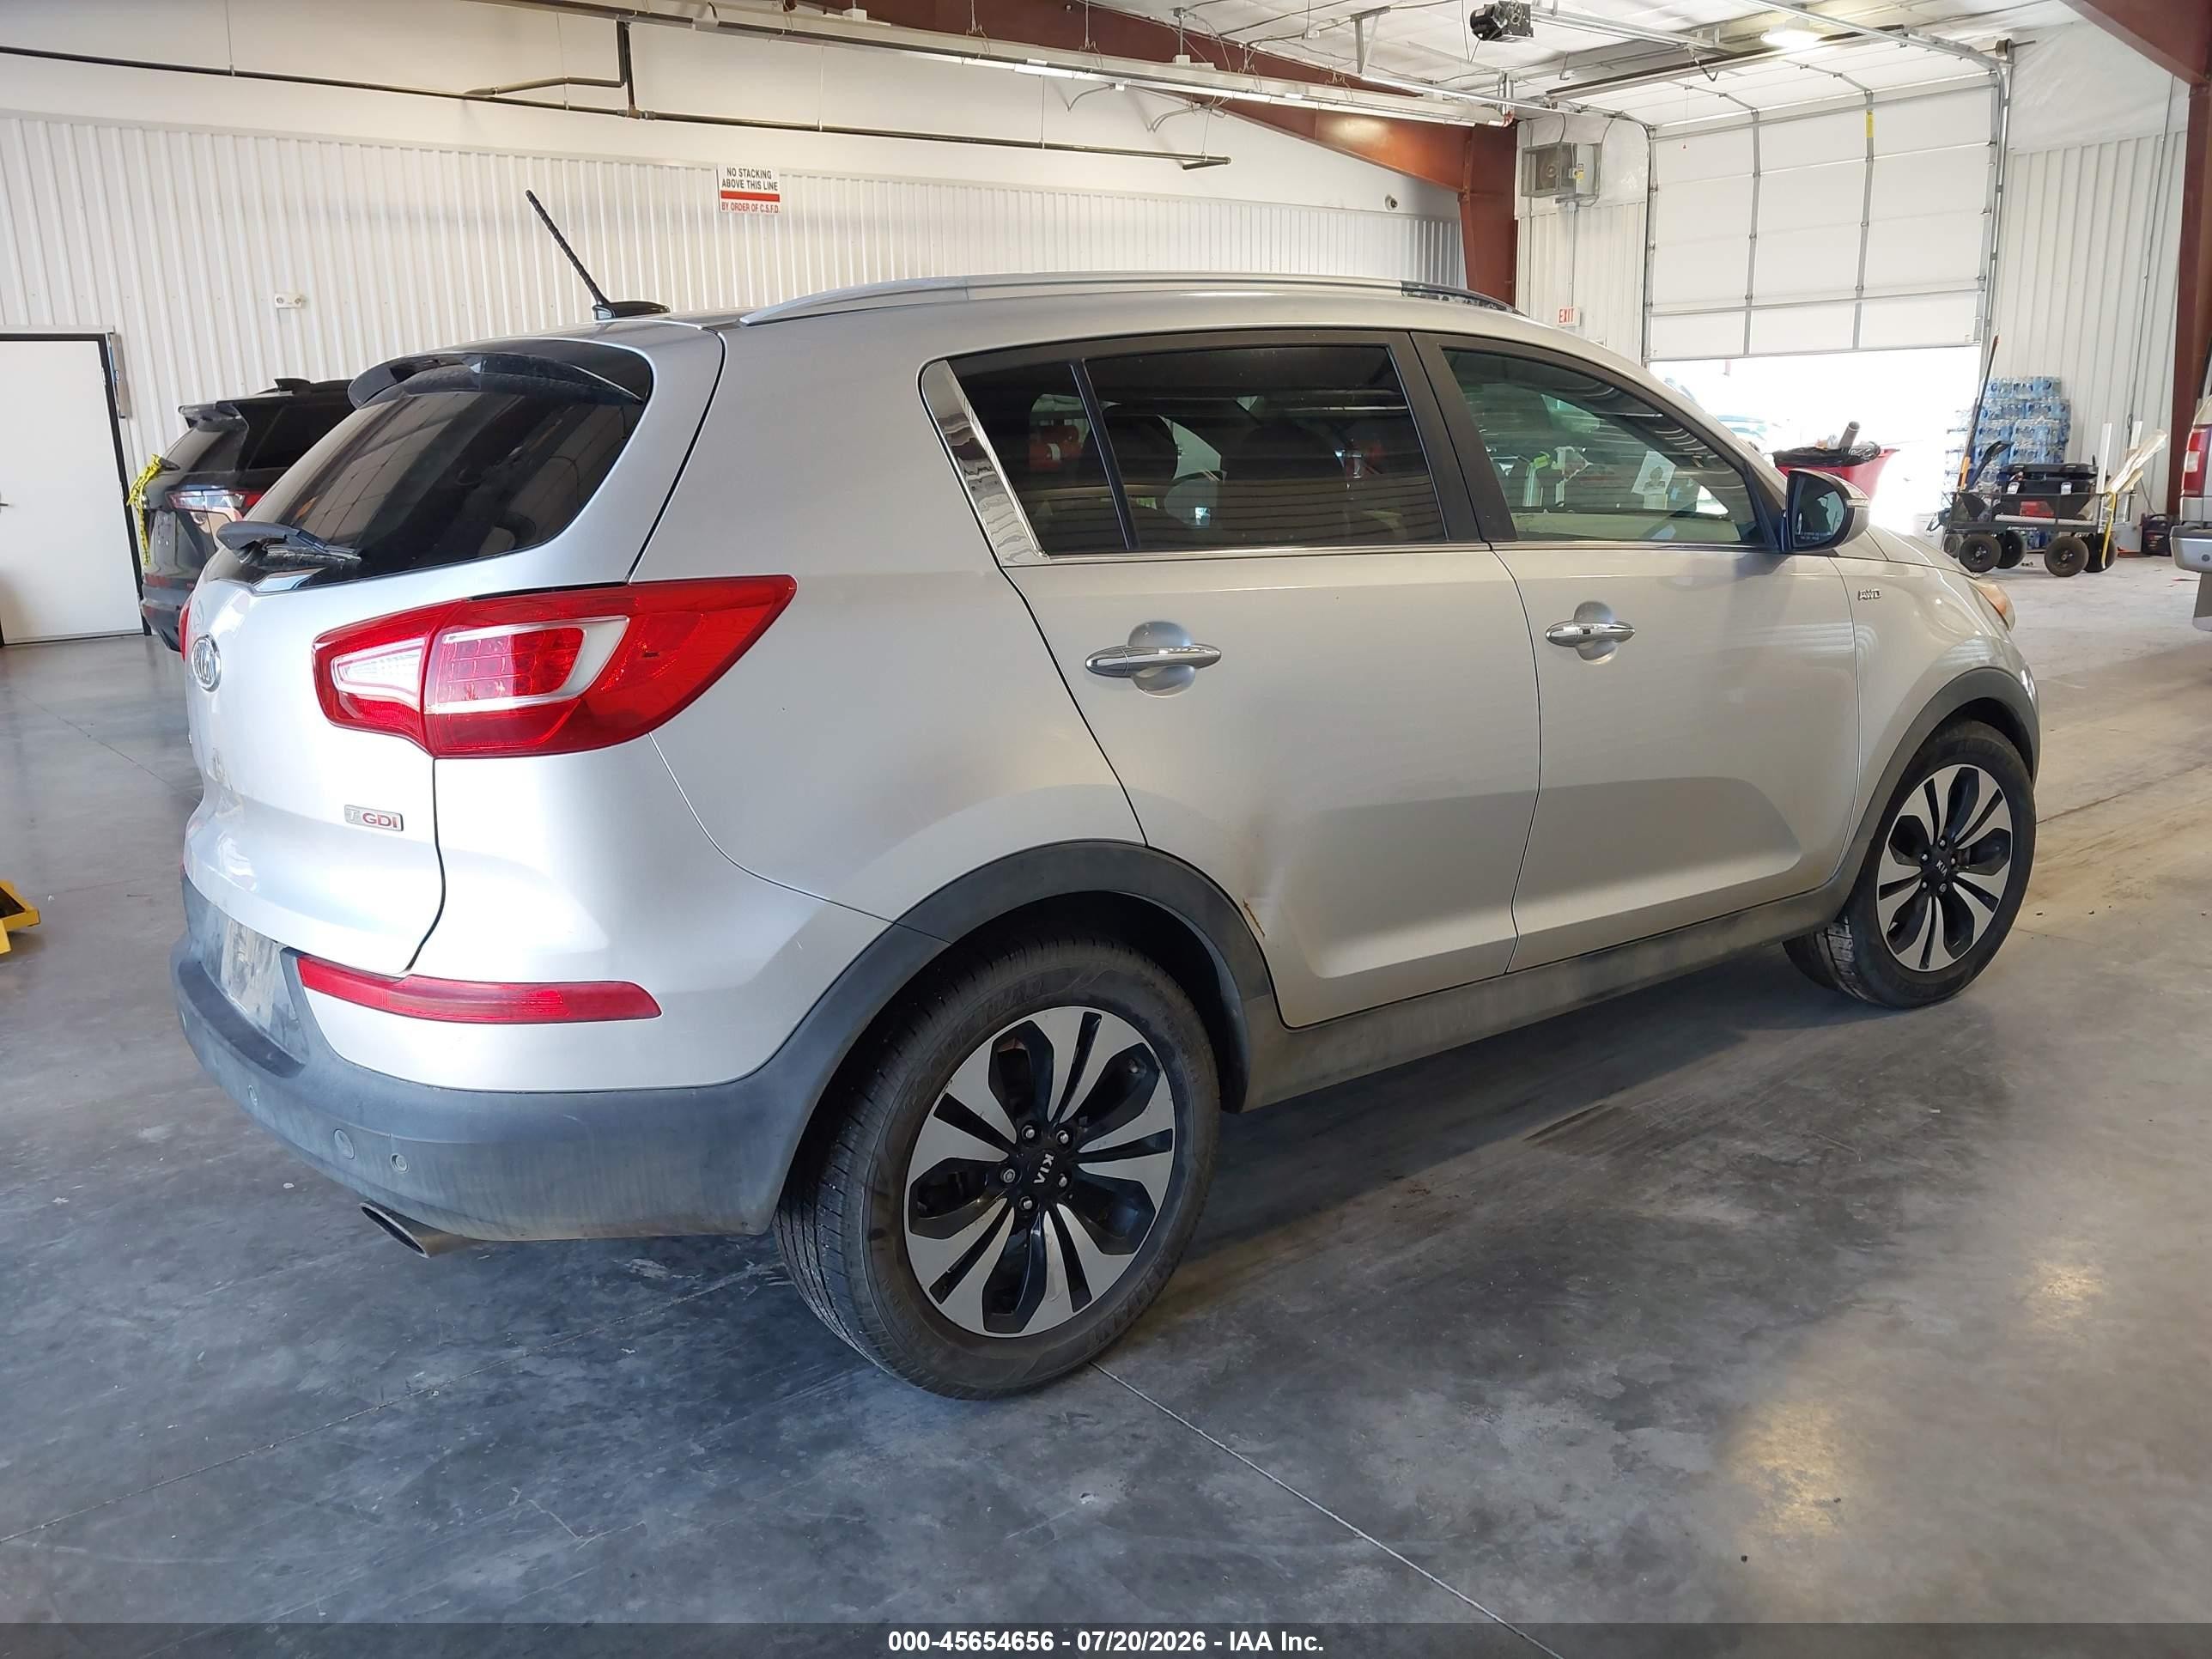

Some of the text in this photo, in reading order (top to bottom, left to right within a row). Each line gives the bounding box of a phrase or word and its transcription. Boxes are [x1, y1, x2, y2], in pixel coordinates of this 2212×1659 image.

[726, 167, 772, 179] NO STACKING
[721, 178, 779, 191] ABOVE THIS LINE
[721, 202, 729, 211] BY
[731, 202, 750, 213] ORDER
[750, 203, 759, 213] OF
[1559, 307, 1574, 324] EXIT
[1857, 589, 1882, 601] AWD
[1936, 859, 1948, 877] KIA
[1033, 1153, 1054, 1184] KIA
